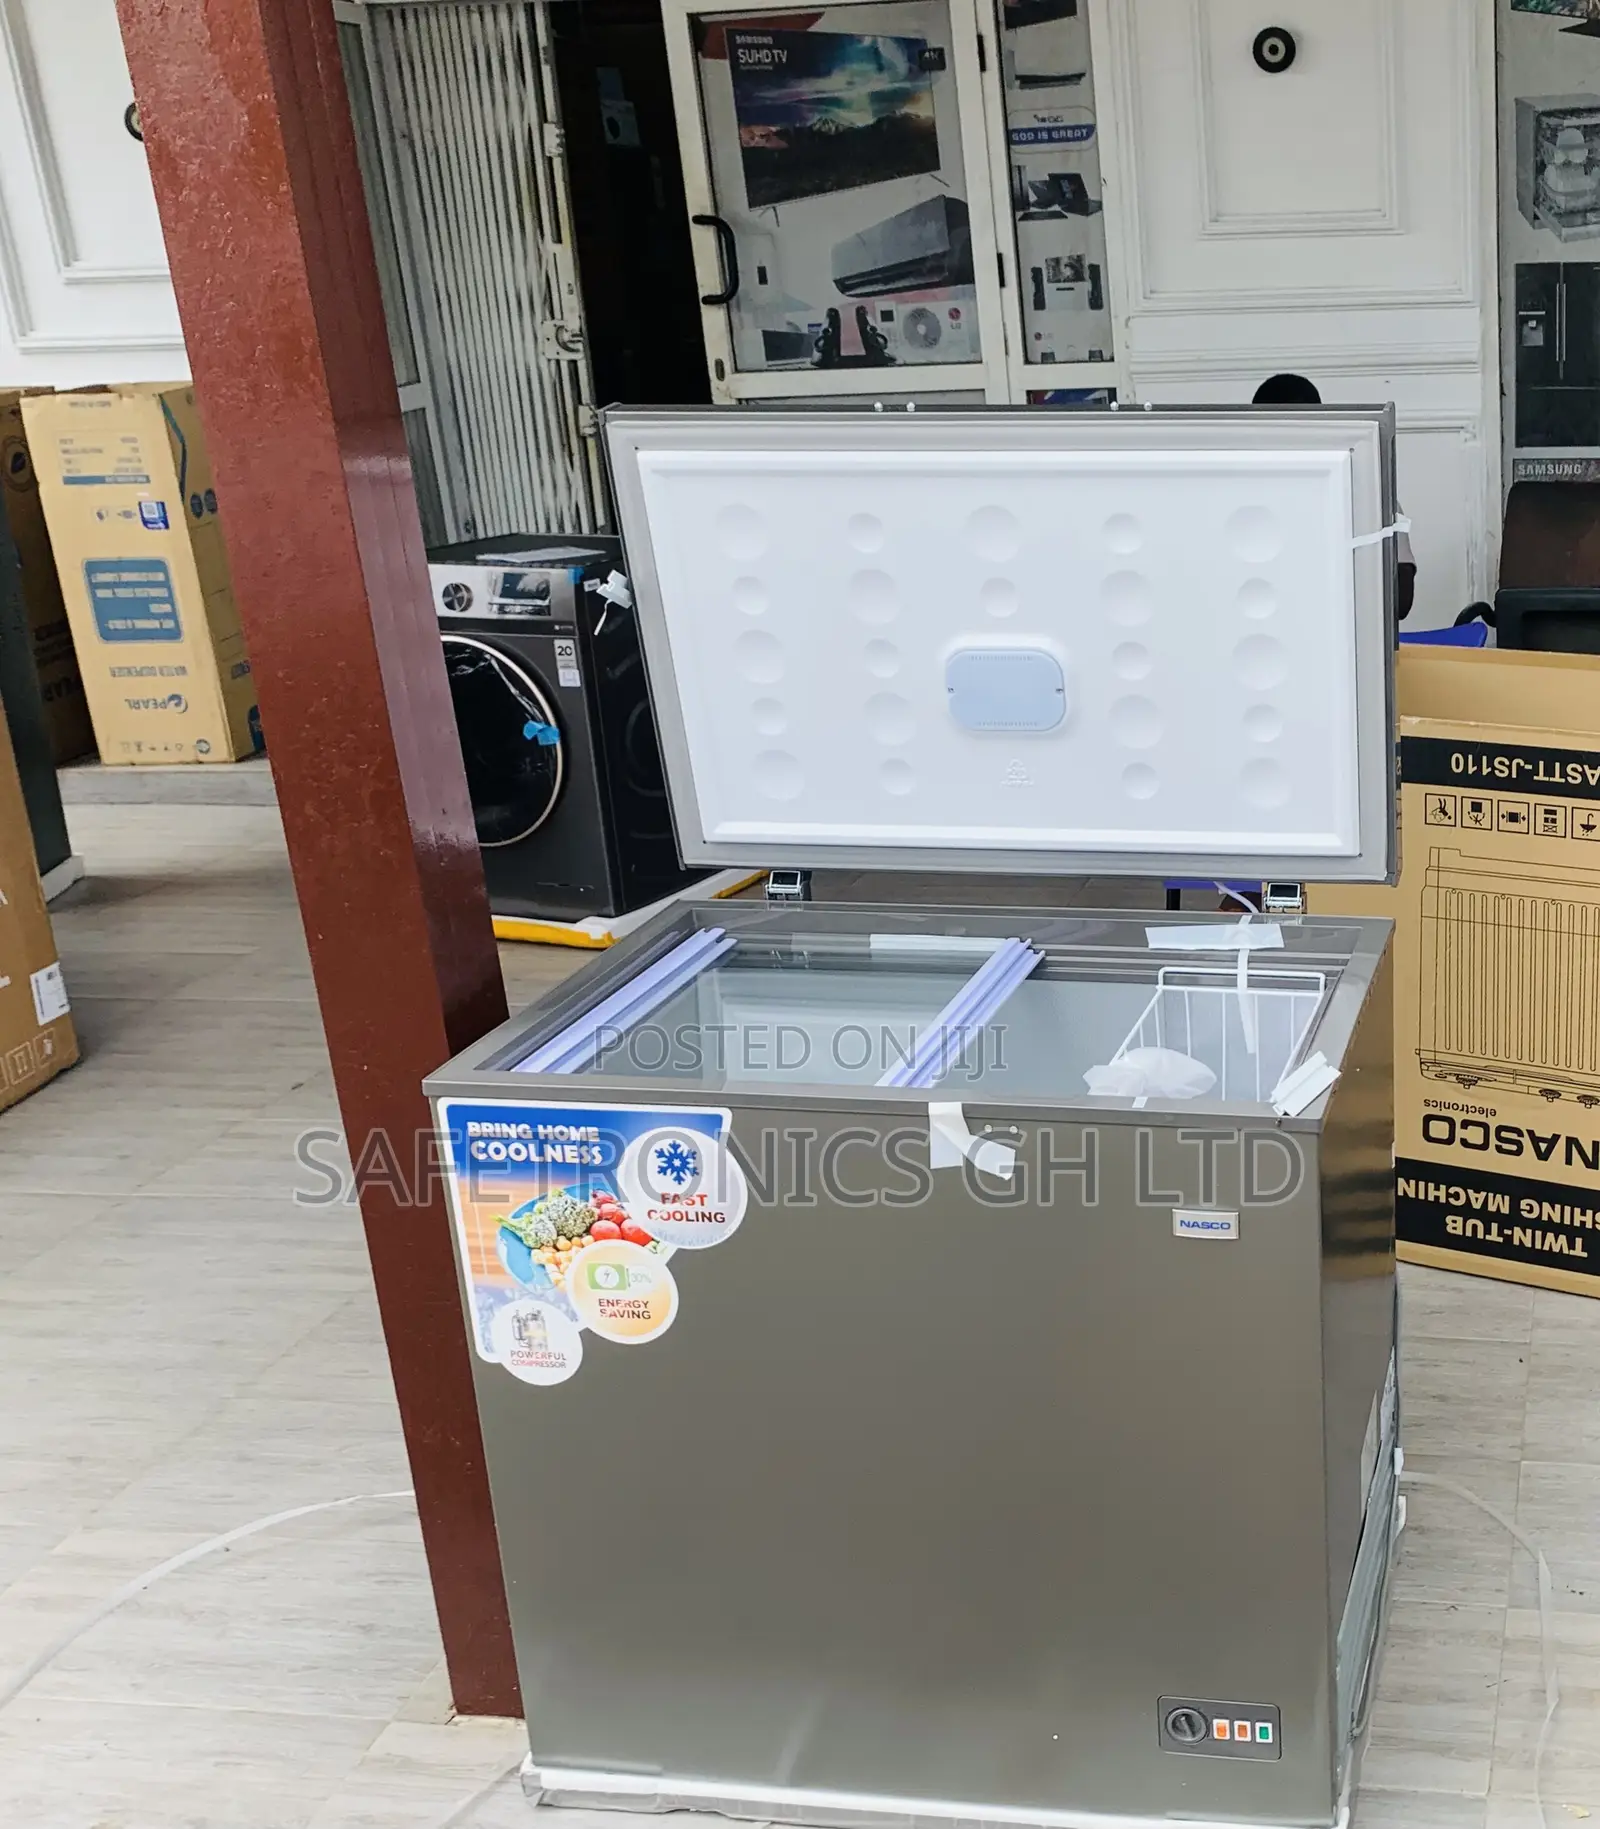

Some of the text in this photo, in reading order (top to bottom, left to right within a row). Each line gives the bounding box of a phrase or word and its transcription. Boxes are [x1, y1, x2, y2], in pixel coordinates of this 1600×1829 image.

[1011, 128, 1089, 142] GOD IS GREAT
[1518, 462, 1582, 476] SAMSUNG
[124, 697, 168, 710] PEARL
[1424, 1098, 1497, 1117] electronics
[466, 1121, 601, 1142] BRING HOME
[1422, 1113, 1600, 1171] NASCO
[470, 1140, 604, 1166] COOLNESS
[660, 1192, 708, 1207] FAST
[1397, 1177, 1600, 1232] HING MACHIN
[647, 1209, 726, 1224] COOLING
[1179, 1219, 1231, 1230] NASCO
[1445, 1214, 1588, 1259] TWIN-TUB
[598, 1298, 649, 1309] ENERGY
[600, 1308, 651, 1320] SAVING
[510, 1350, 567, 1361] POWERFUL
